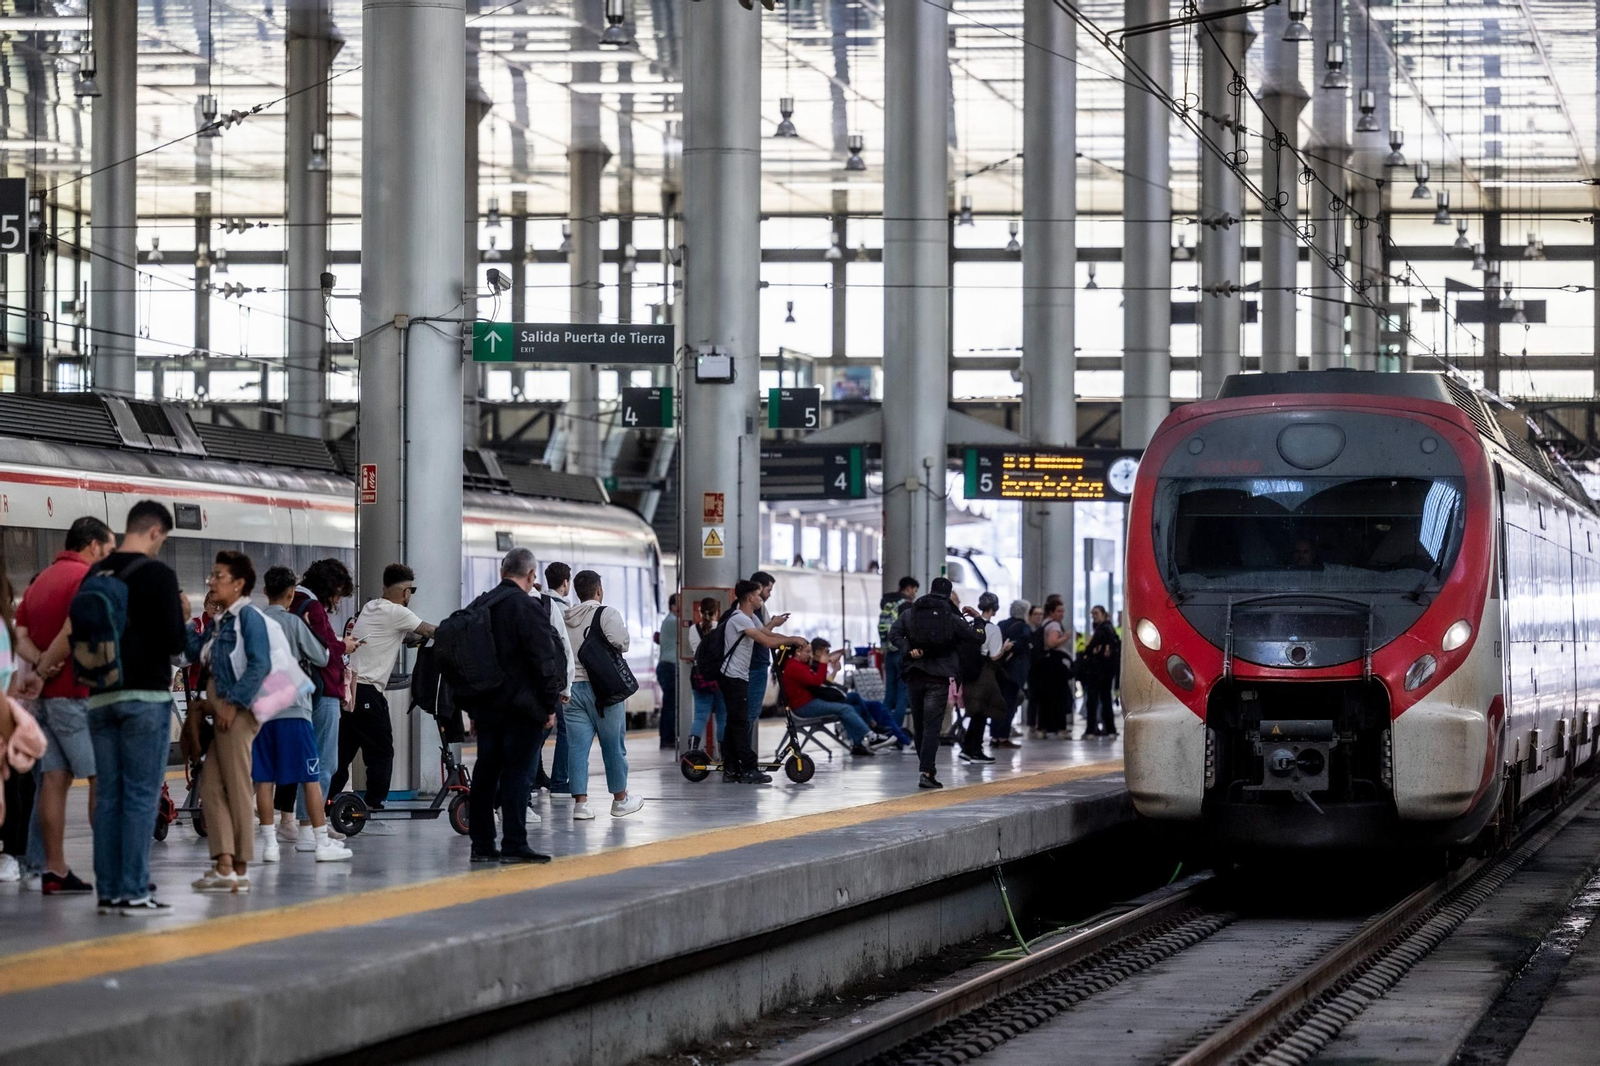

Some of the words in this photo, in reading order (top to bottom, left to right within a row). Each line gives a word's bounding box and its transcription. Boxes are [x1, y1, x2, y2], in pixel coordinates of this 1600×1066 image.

[1, 214, 20, 249] 5
[521, 330, 560, 343] Salida
[564, 331, 605, 344] Puerta
[610, 332, 626, 344] de
[630, 332, 666, 344] Tierra
[625, 406, 639, 426] 4
[805, 407, 817, 427] 5
[834, 472, 847, 490] 4
[980, 473, 993, 492] 5
